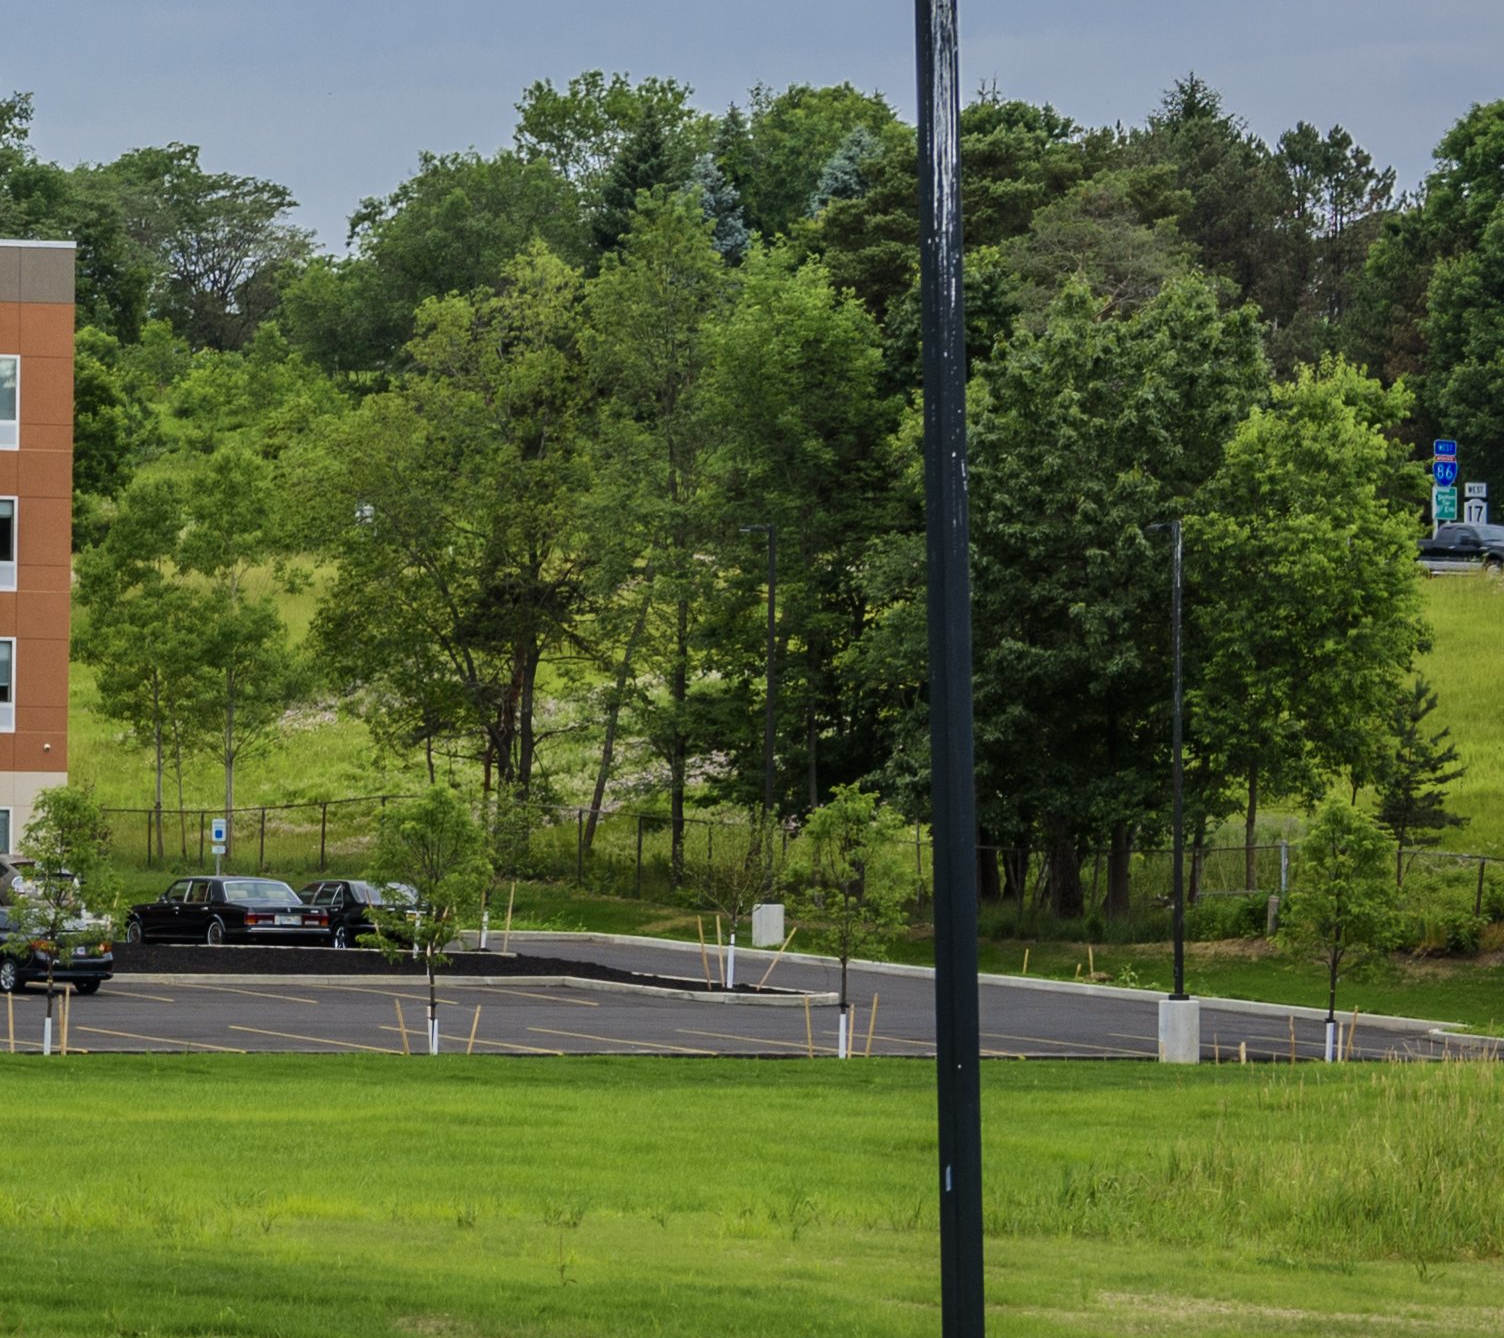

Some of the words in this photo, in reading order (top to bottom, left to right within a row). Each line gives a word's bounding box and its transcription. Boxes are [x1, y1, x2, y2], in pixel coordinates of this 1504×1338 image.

[1437, 464, 1453, 479] 86
[1468, 486, 1484, 494] WEST
[1469, 505, 1483, 522] 17
